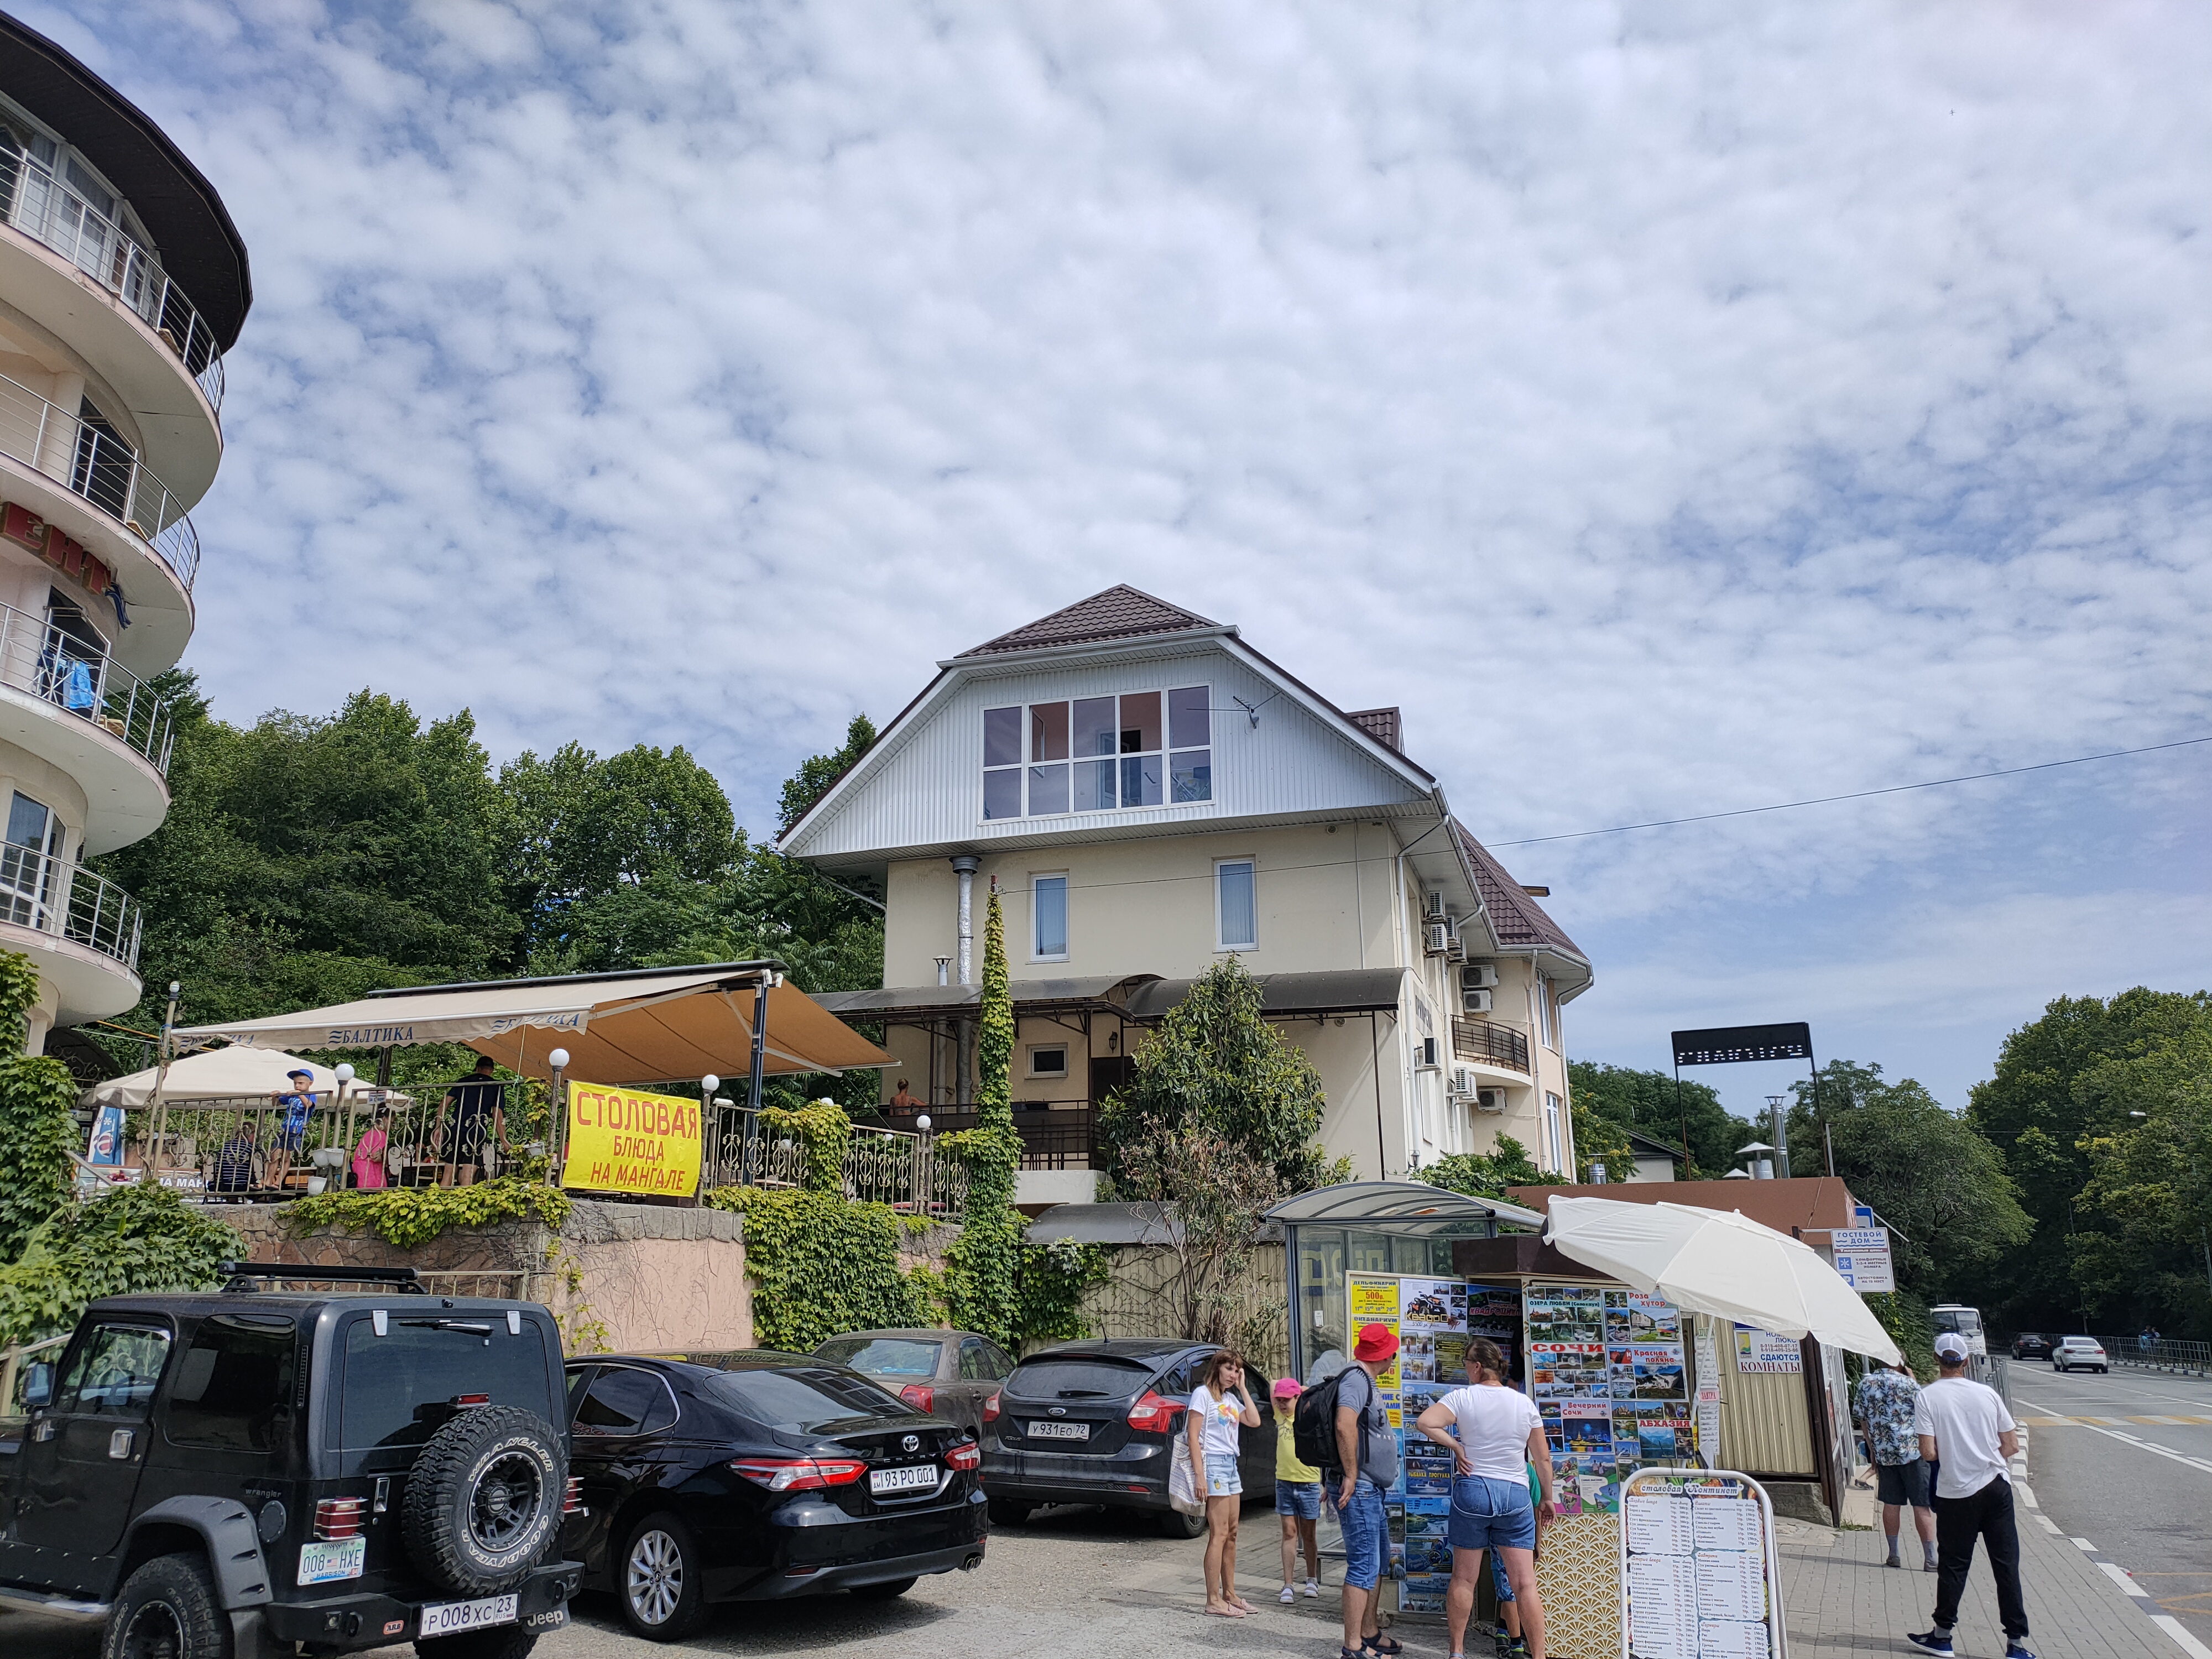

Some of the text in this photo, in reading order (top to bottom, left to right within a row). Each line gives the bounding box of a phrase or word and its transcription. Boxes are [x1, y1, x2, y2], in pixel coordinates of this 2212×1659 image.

[342, 1026, 414, 1044] БАЛТИКА
[577, 1091, 697, 1140] СТОЛОВАЯ
[614, 1135, 664, 1165] БЛЮДА
[591, 1162, 685, 1190] НА МАНГАЛЕ
[1532, 1344, 1604, 1353] СОЧИ
[1760, 1354, 1799, 1362] СДАЮТСЯ
[1740, 1362, 1801, 1372] КОМНАТЫ
[1702, 1391, 1716, 1400] ЗАВТРА
[1076, 1425, 1086, 1434] 72
[468, 1437, 554, 1482] WRANGLER
[883, 1453, 936, 1463] CAMRY
[885, 1472, 898, 1488] 93
[917, 1467, 935, 1483] 001
[245, 1489, 281, 1499] wrangler
[1642, 1484, 1681, 1492] столовая
[303, 1549, 362, 1573] 008 HXE
[316, 1569, 346, 1578] HARRISON
[497, 1597, 512, 1613] 23
[527, 1609, 564, 1627] Jeep
